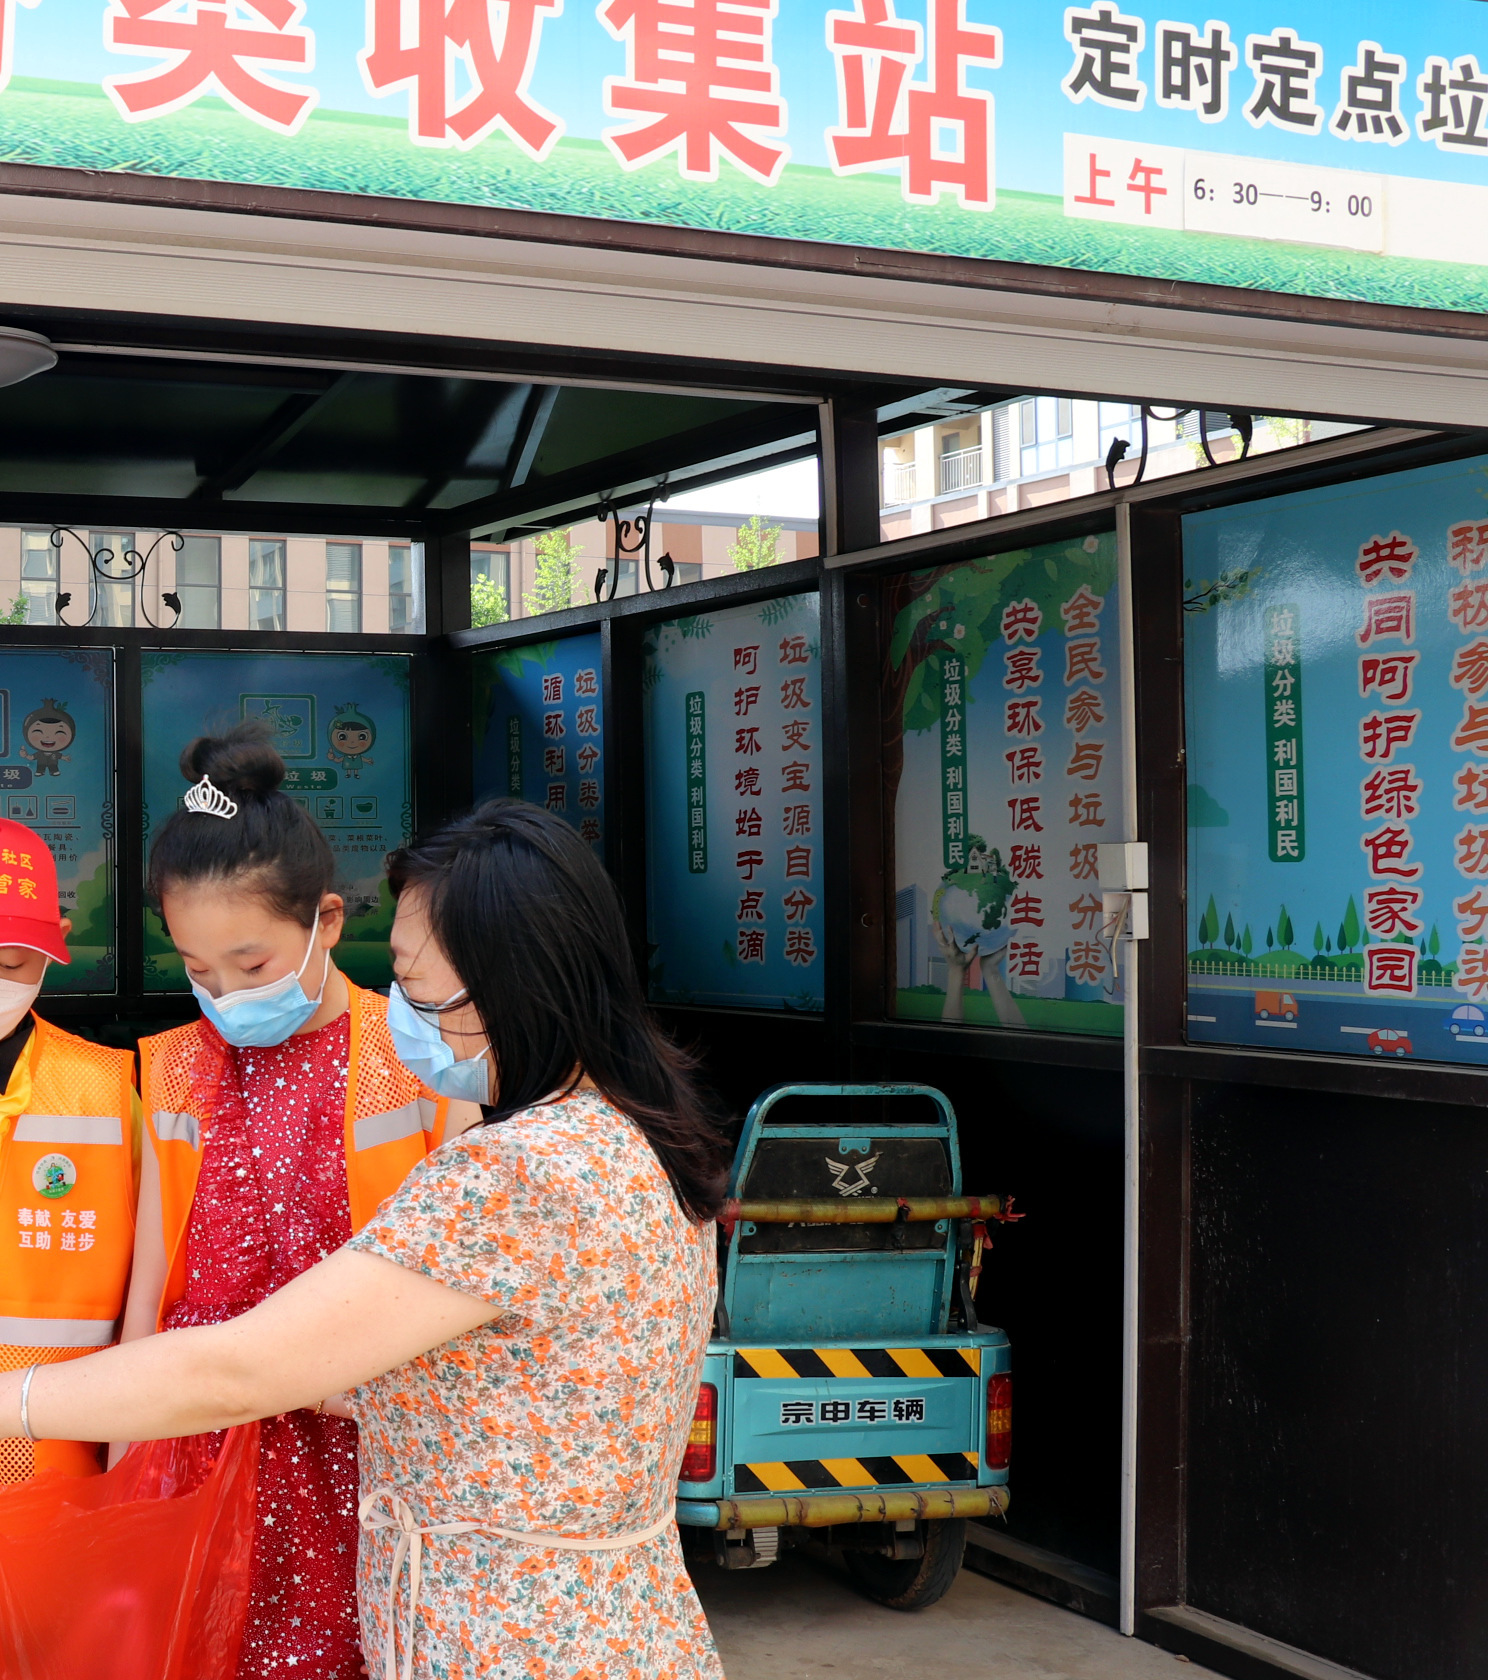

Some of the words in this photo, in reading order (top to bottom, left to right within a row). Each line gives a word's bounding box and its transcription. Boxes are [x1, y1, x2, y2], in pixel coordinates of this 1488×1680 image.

[1069, 9, 1488, 147] 定时定点垃
[1074, 152, 1168, 215] 上午
[943, 659, 962, 757] 垃圾分类
[1270, 608, 1296, 728] 垃圾分类
[544, 676, 565, 810] 循环利用
[689, 696, 703, 780] 垃圾分类
[1003, 602, 1045, 976] 共享环保低碳生活
[1061, 592, 1106, 981] 全民参与垃圾分类
[1359, 535, 1420, 994] 共同呵护绿色家园
[37, 833, 80, 841] 瓦陶瓷、
[691, 786, 705, 870] 利国利民
[734, 645, 765, 962] 呵护环境始于点滴
[779, 636, 815, 963] 垃圾变宝源自分类
[945, 766, 965, 865] 利国利民
[1274, 737, 1300, 858] 利国利民
[17, 1207, 52, 1228] 奉献
[61, 1209, 97, 1230] 友爱
[18, 1230, 52, 1251] 互助
[60, 1232, 96, 1252] 进步
[780, 1397, 926, 1426] 宗申车辆
